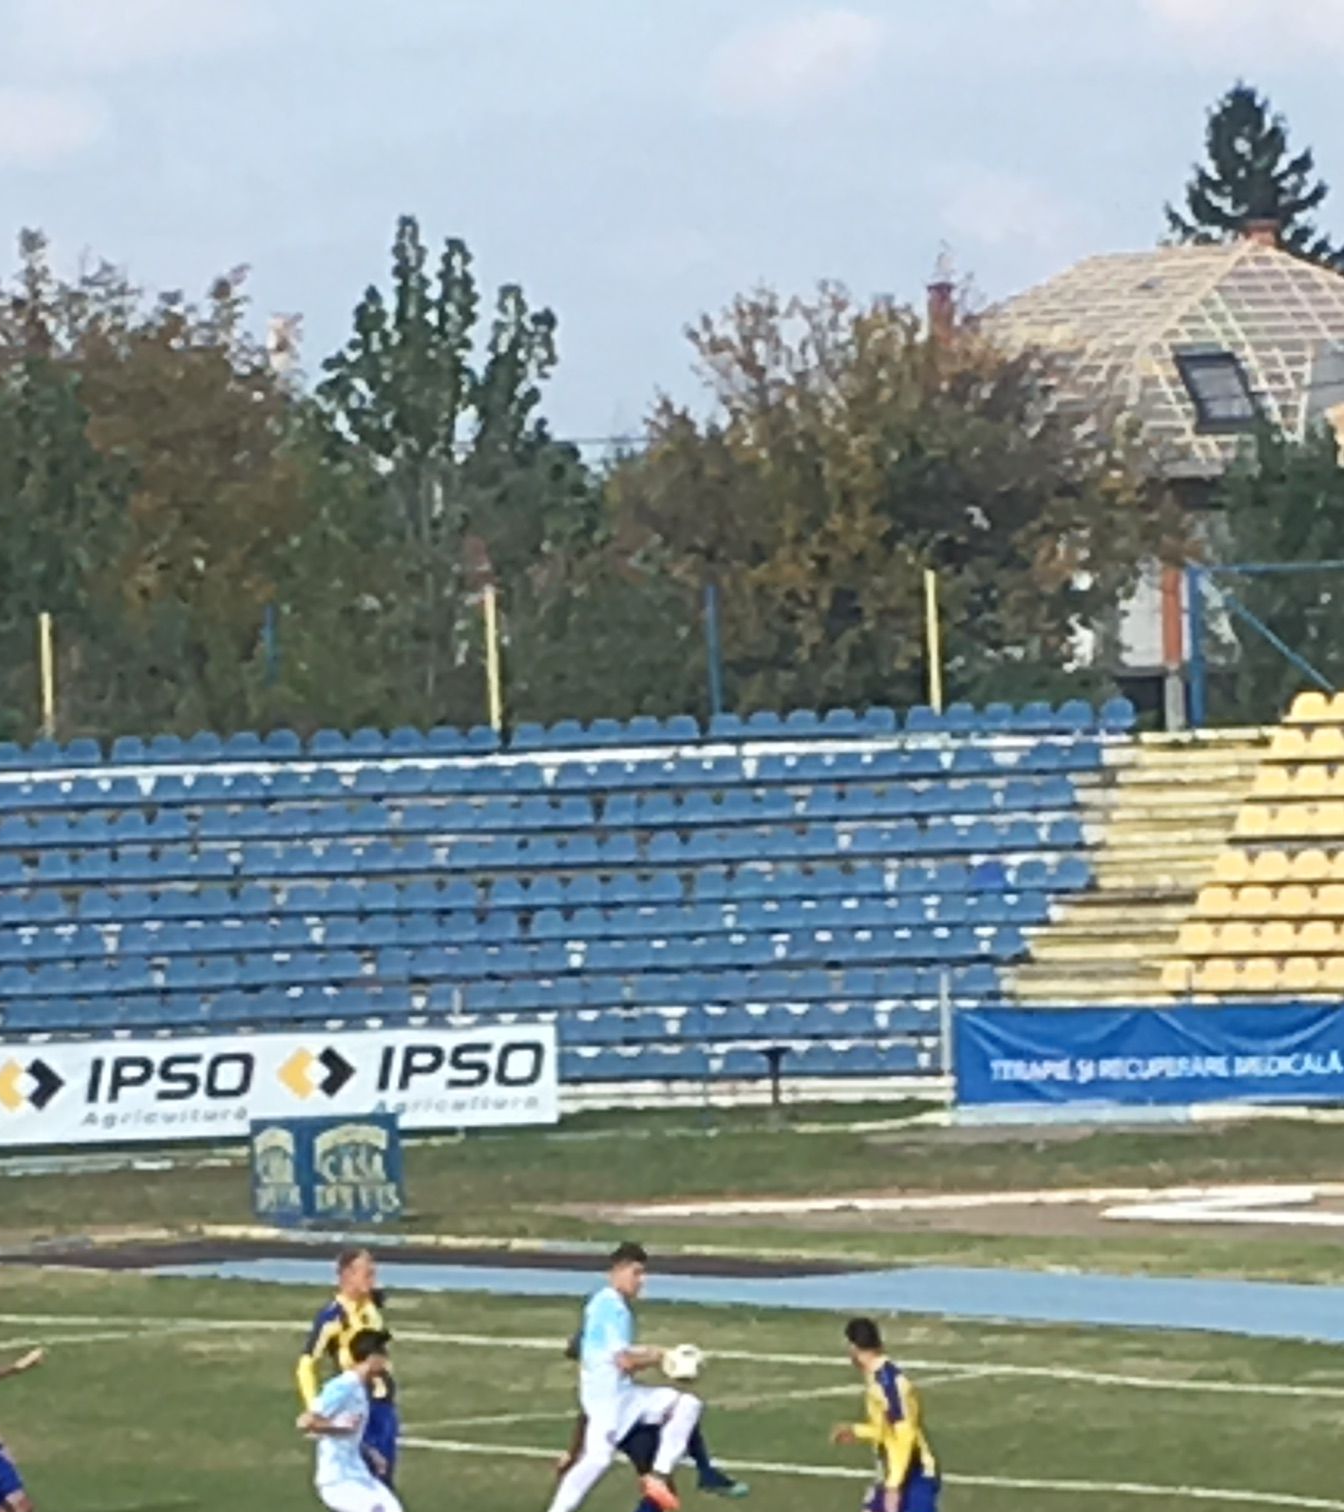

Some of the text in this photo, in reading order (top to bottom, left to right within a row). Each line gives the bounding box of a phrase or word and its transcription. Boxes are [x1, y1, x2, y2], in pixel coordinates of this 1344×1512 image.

[86, 1051, 255, 1104] IPSO
[376, 1041, 546, 1092] IPSO
[1098, 1055, 1230, 1081] RECUPERARE
